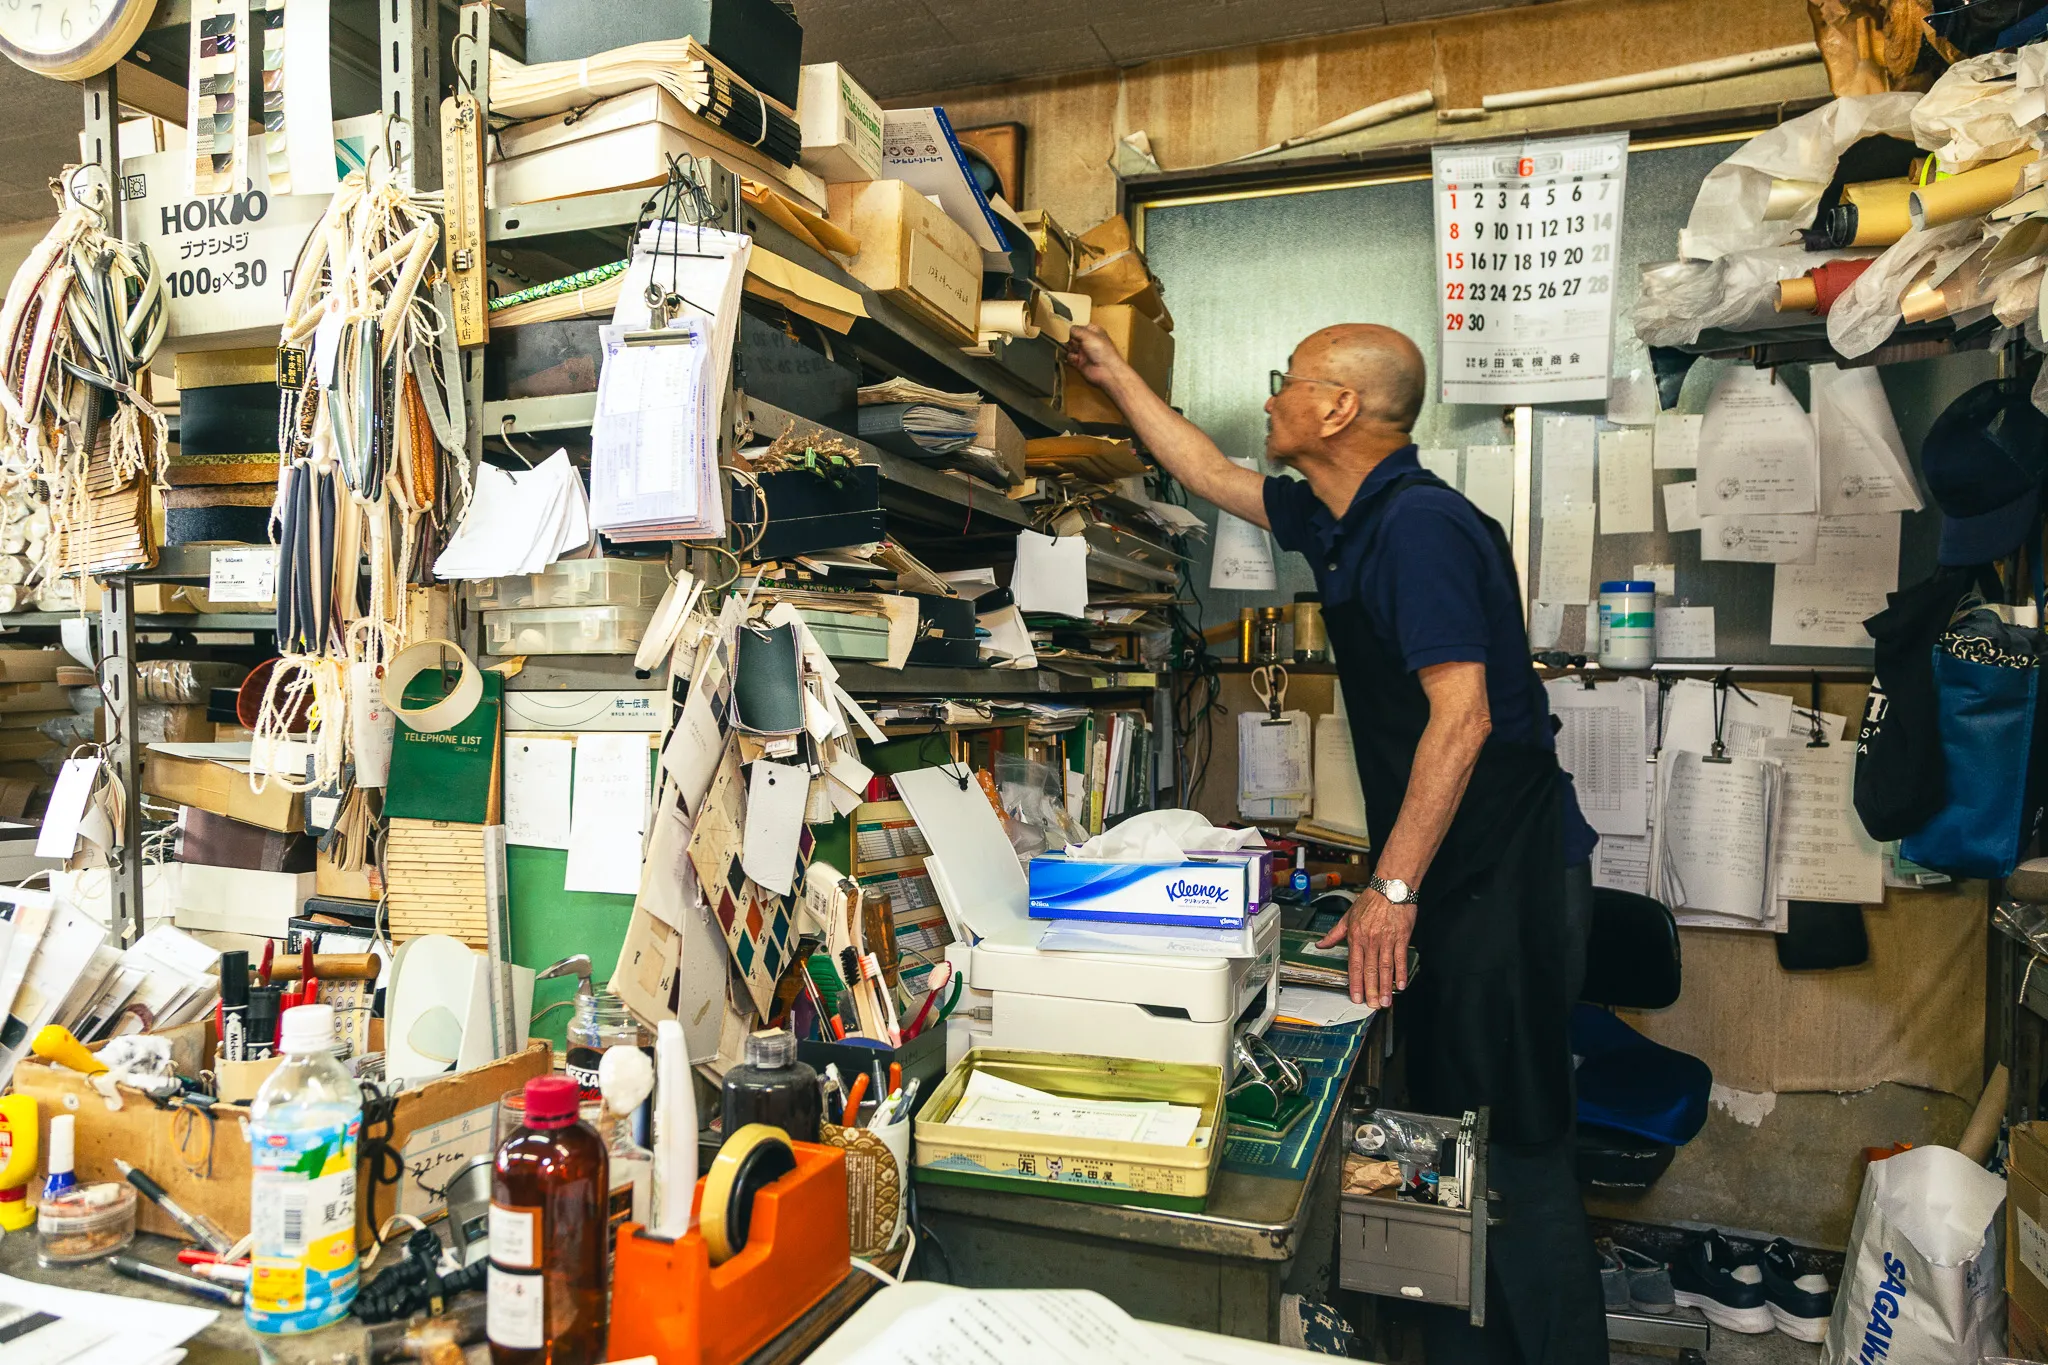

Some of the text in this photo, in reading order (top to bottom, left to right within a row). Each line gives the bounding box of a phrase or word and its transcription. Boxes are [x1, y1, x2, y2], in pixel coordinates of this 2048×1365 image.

[1518, 157, 1534, 177] 6
[1450, 193, 1457, 209] 1
[1474, 192, 1484, 209] 2
[1498, 192, 1507, 209] 3
[1520, 192, 1530, 209] 4
[1546, 188, 1556, 206] 5
[1572, 185, 1582, 201] 6
[1449, 213, 1612, 240] 8 9 10 11 12 13 14
[180, 232, 250, 260] ブナシメジ
[1446, 244, 1610, 271] 15 16 17 18 19 20 21
[1446, 275, 1609, 301] 22 23 24 25 26 27 28
[1446, 314, 1484, 331] 29 30
[616, 698, 650, 709] 統一伝票
[404, 732, 482, 745] TELEPHONE LIST
[1165, 879, 1229, 903] Kleenex
[1219, 917, 1240, 926] Kleenex
[1071, 1167, 1113, 1181] 石田屋
